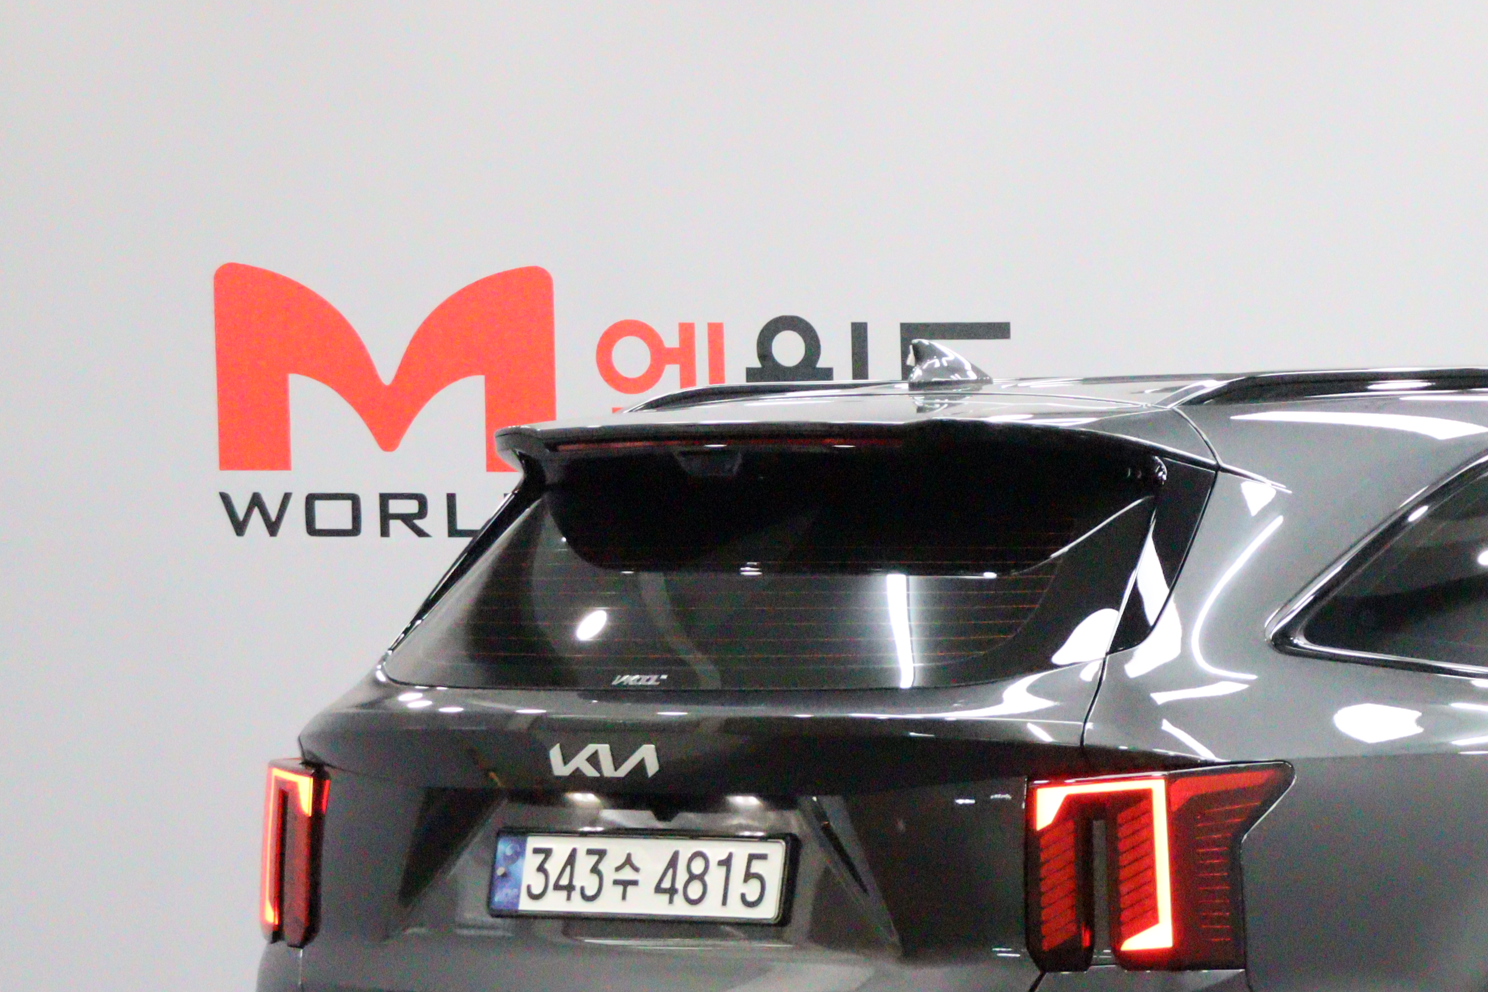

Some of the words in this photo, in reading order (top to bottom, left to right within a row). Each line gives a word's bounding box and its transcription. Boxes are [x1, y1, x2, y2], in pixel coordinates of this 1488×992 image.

[213, 262, 556, 473] M
[218, 492, 513, 538] WORL
[549, 743, 660, 778] KIA
[525, 846, 641, 901] 343수
[654, 849, 769, 909] 4815
